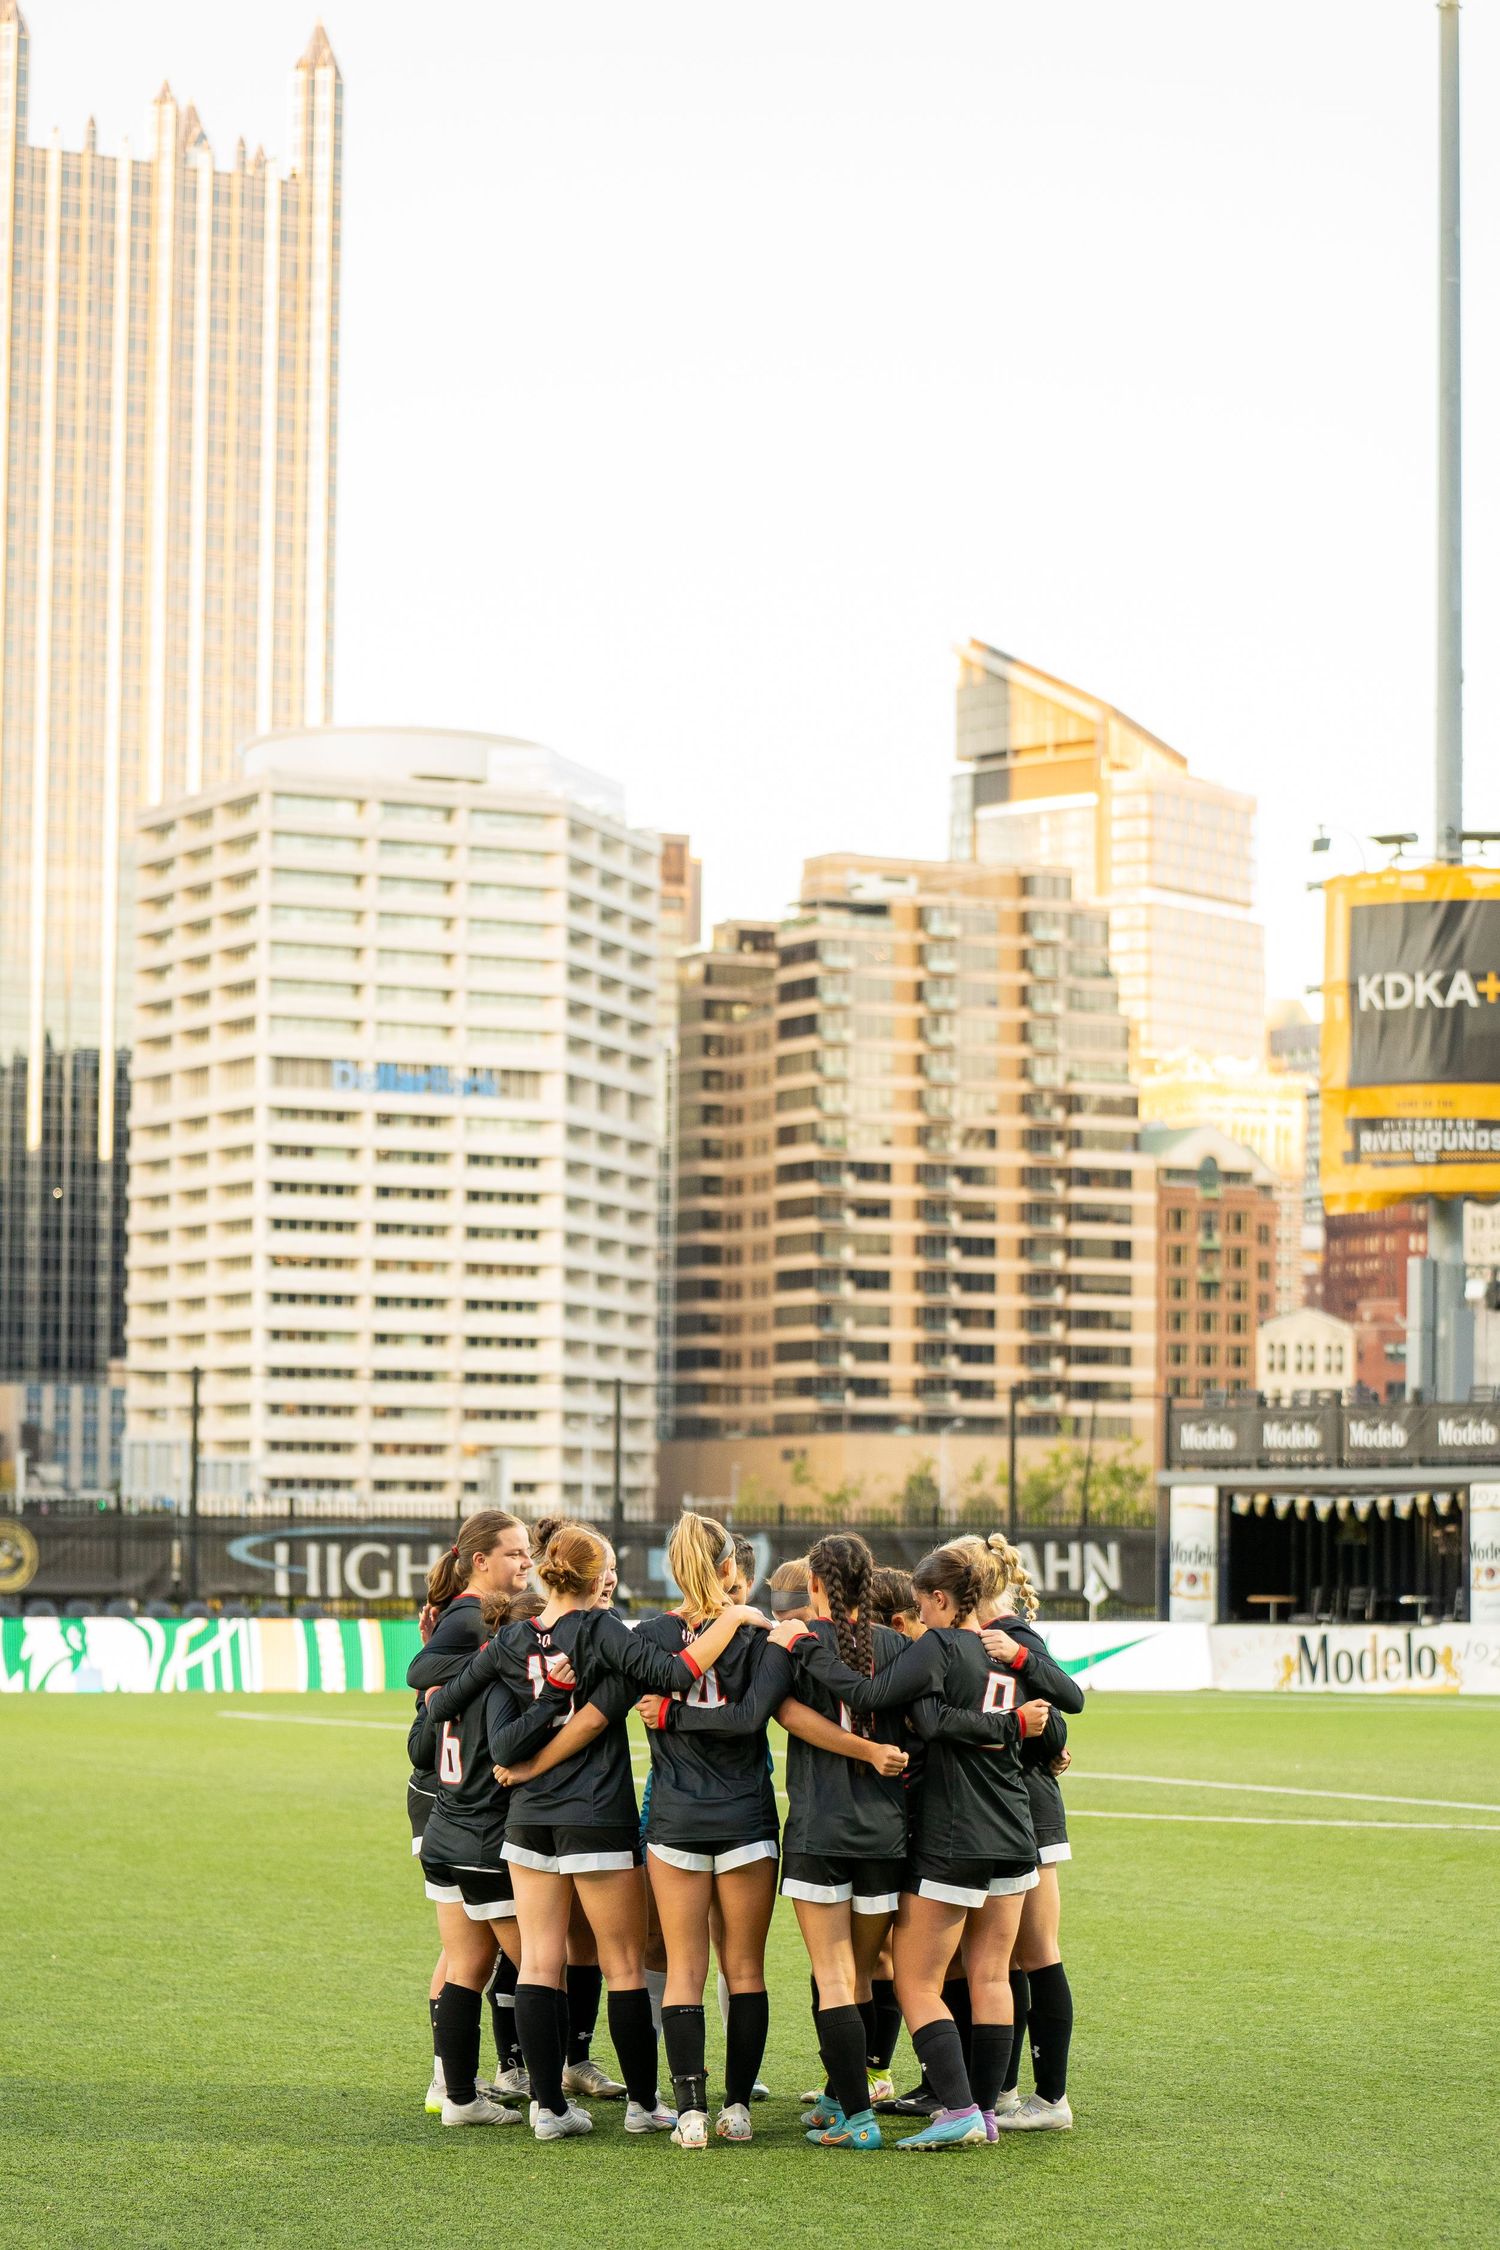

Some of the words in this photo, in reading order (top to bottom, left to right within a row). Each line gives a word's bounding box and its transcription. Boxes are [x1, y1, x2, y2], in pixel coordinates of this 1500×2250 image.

[1180, 1422, 1237, 1450] Modelo
[1262, 1421, 1322, 1449] Modelo
[1349, 1419, 1408, 1448] Modelo
[1438, 1417, 1499, 1447] Modelo
[1297, 1631, 1437, 1684] Modelo
[439, 1713, 463, 1785] 6
